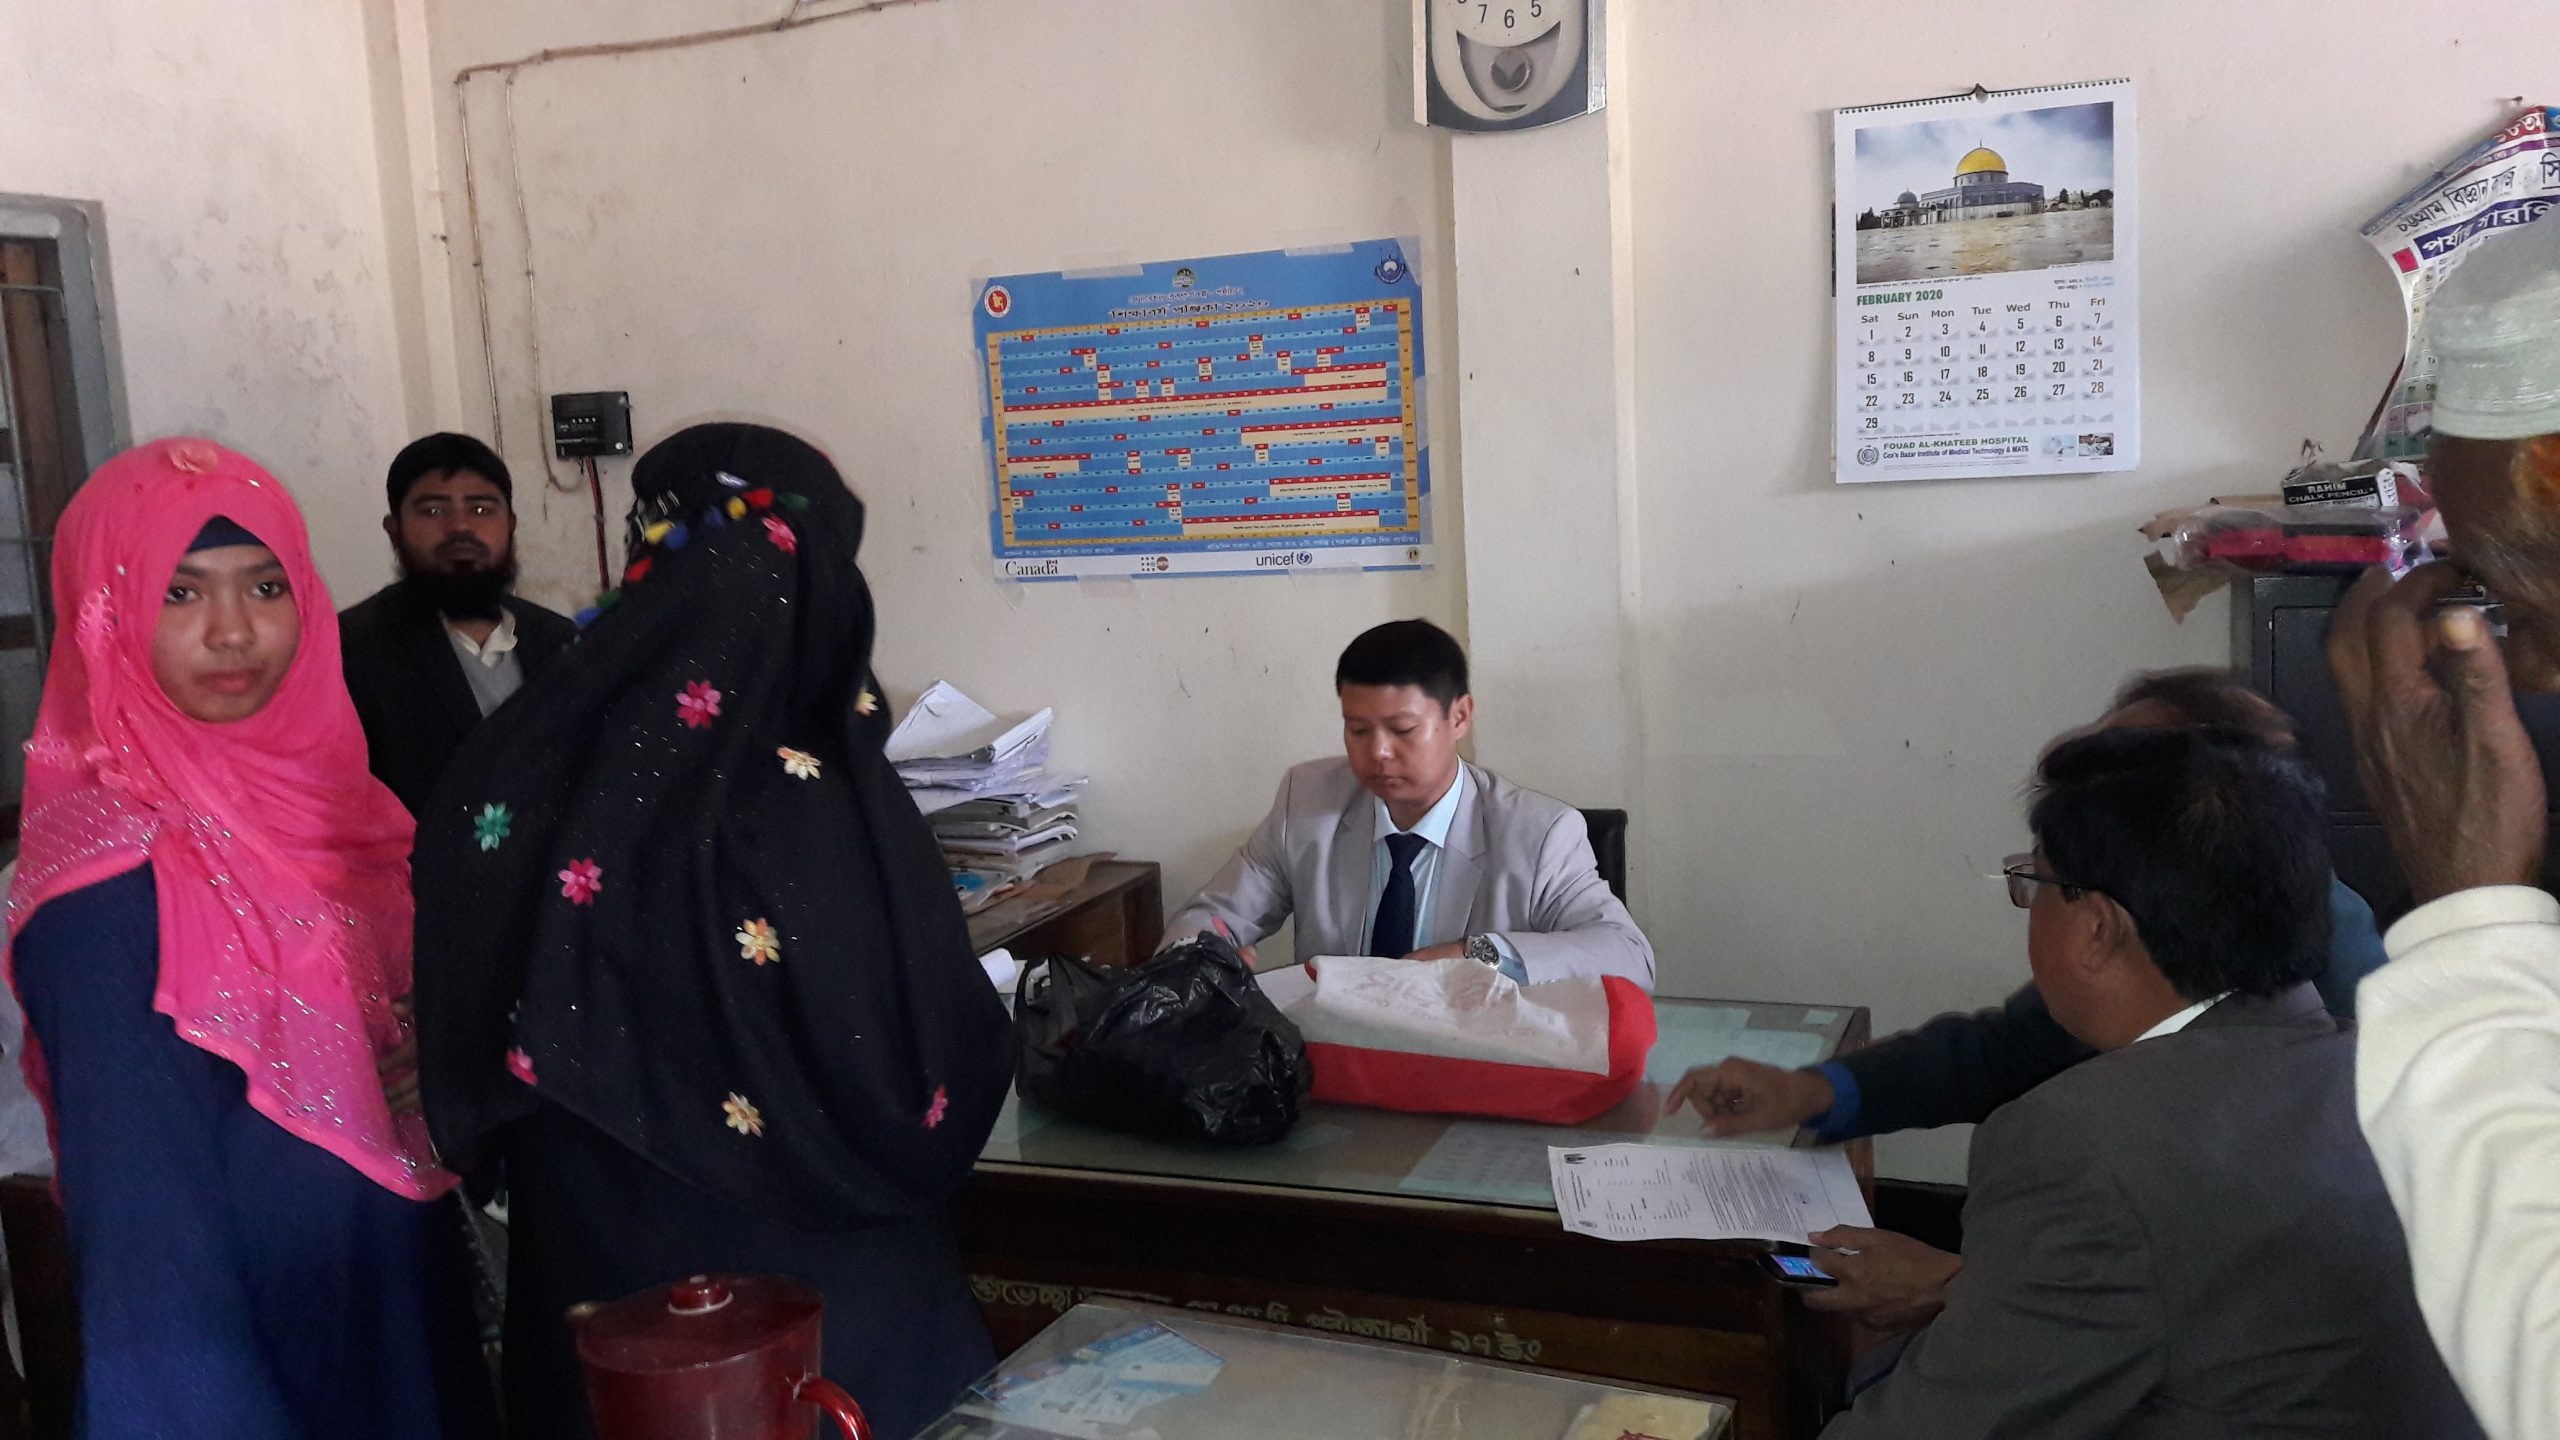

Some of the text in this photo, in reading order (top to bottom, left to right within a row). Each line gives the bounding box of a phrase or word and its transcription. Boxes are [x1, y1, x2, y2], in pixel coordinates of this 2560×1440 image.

[1478, 4, 1487, 23] 7
[1530, 0, 1542, 18] 5
[1504, 8, 1515, 29] 6
[1856, 289, 1944, 307] FEBRUARY 2020
[1861, 297, 2106, 324] Sat Sun Mon Tue Wed Thu Fri
[1905, 326, 1912, 338] 2
[1942, 323, 1949, 335] 3
[1979, 321, 1986, 332] 4
[2017, 317, 2024, 330] 5
[2055, 315, 2062, 327] 6
[2094, 312, 2101, 324] 7
[1868, 335, 2103, 363] 8 9 10 11 12 13 14
[1867, 358, 2103, 385] 15 16 17 18 19 20 21
[1865, 381, 2104, 407] 22 23 24 25 26 27 28
[1865, 417, 1878, 429] 29
[1883, 436, 2029, 450] FOUAD AL-KHATEEB HOSPITAL
[2288, 489, 2368, 503] CHALK PENCIL
[2307, 482, 2347, 494] RAHIM
[1005, 559, 1059, 576] Canada
[1256, 552, 1295, 567] unicef
